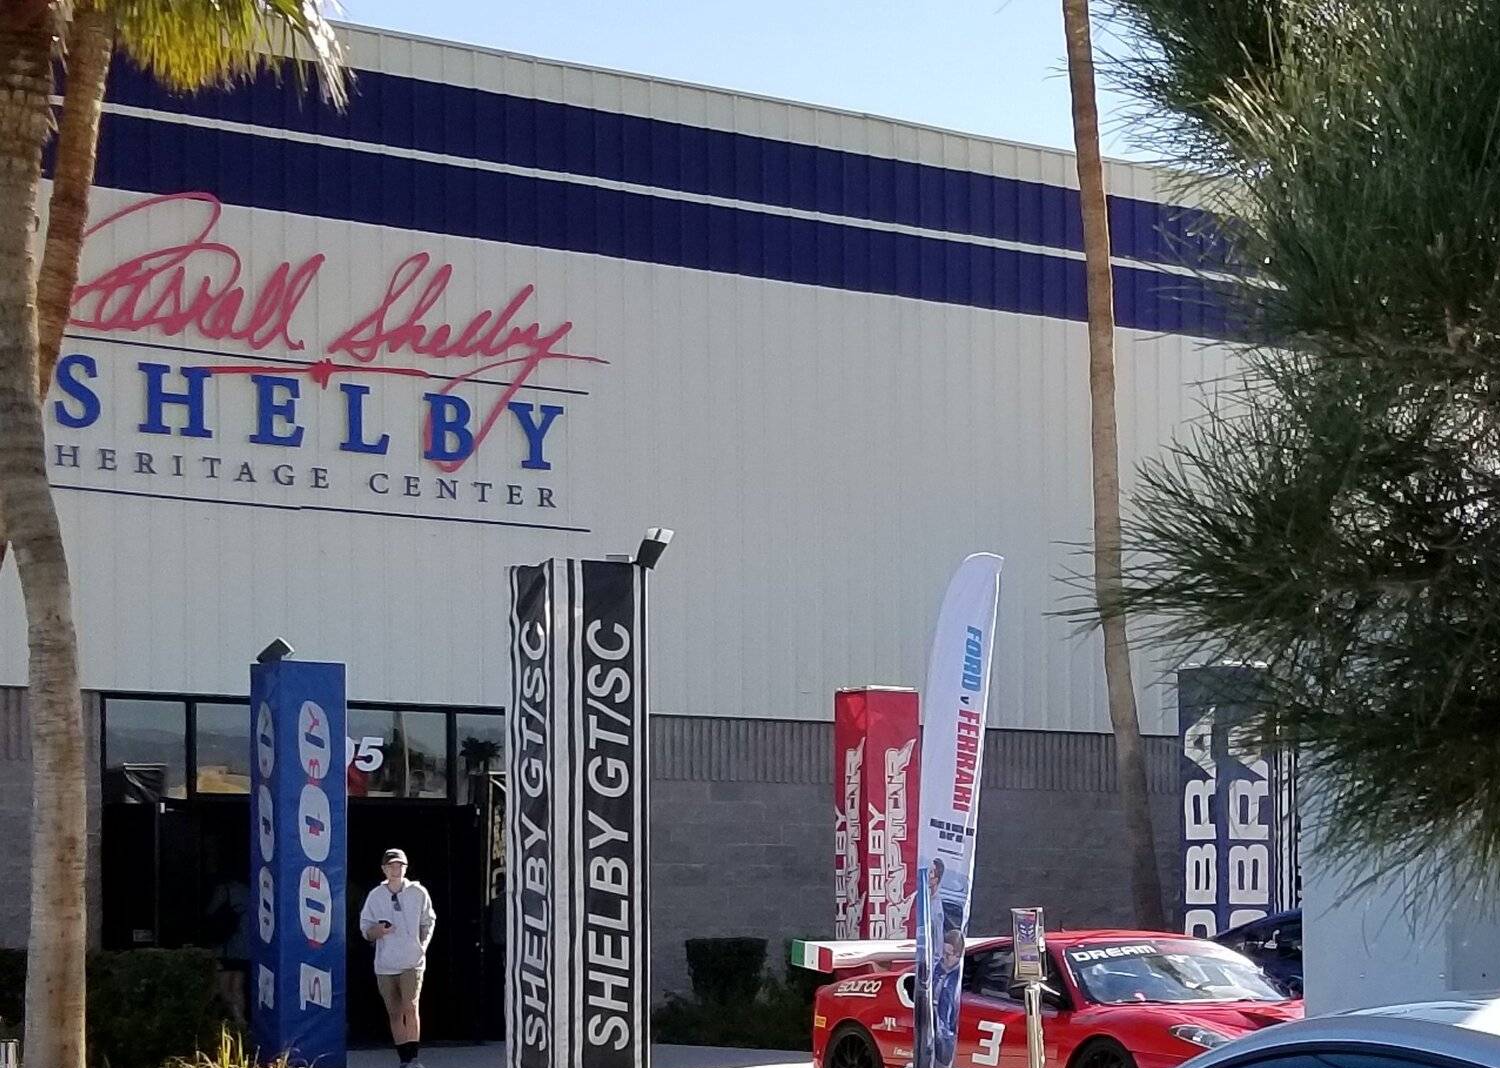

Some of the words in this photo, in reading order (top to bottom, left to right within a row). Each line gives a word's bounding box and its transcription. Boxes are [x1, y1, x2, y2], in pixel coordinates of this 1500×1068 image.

[55, 354, 564, 470] SHELBY
[54, 444, 330, 490] HERITAGE
[368, 472, 557, 509] CENTER
[520, 620, 546, 798] GT/SC
[586, 619, 632, 798] GT/SC
[961, 625, 983, 692] FORD
[952, 708, 981, 813] FERRARI
[521, 812, 548, 1051] SHELBY
[587, 809, 631, 1051] SHELBY
[835, 804, 848, 939] SHELBY
[868, 802, 886, 939] SHELBY
[1070, 945, 1157, 963] DREAM
[971, 1019, 1006, 1066] 3
